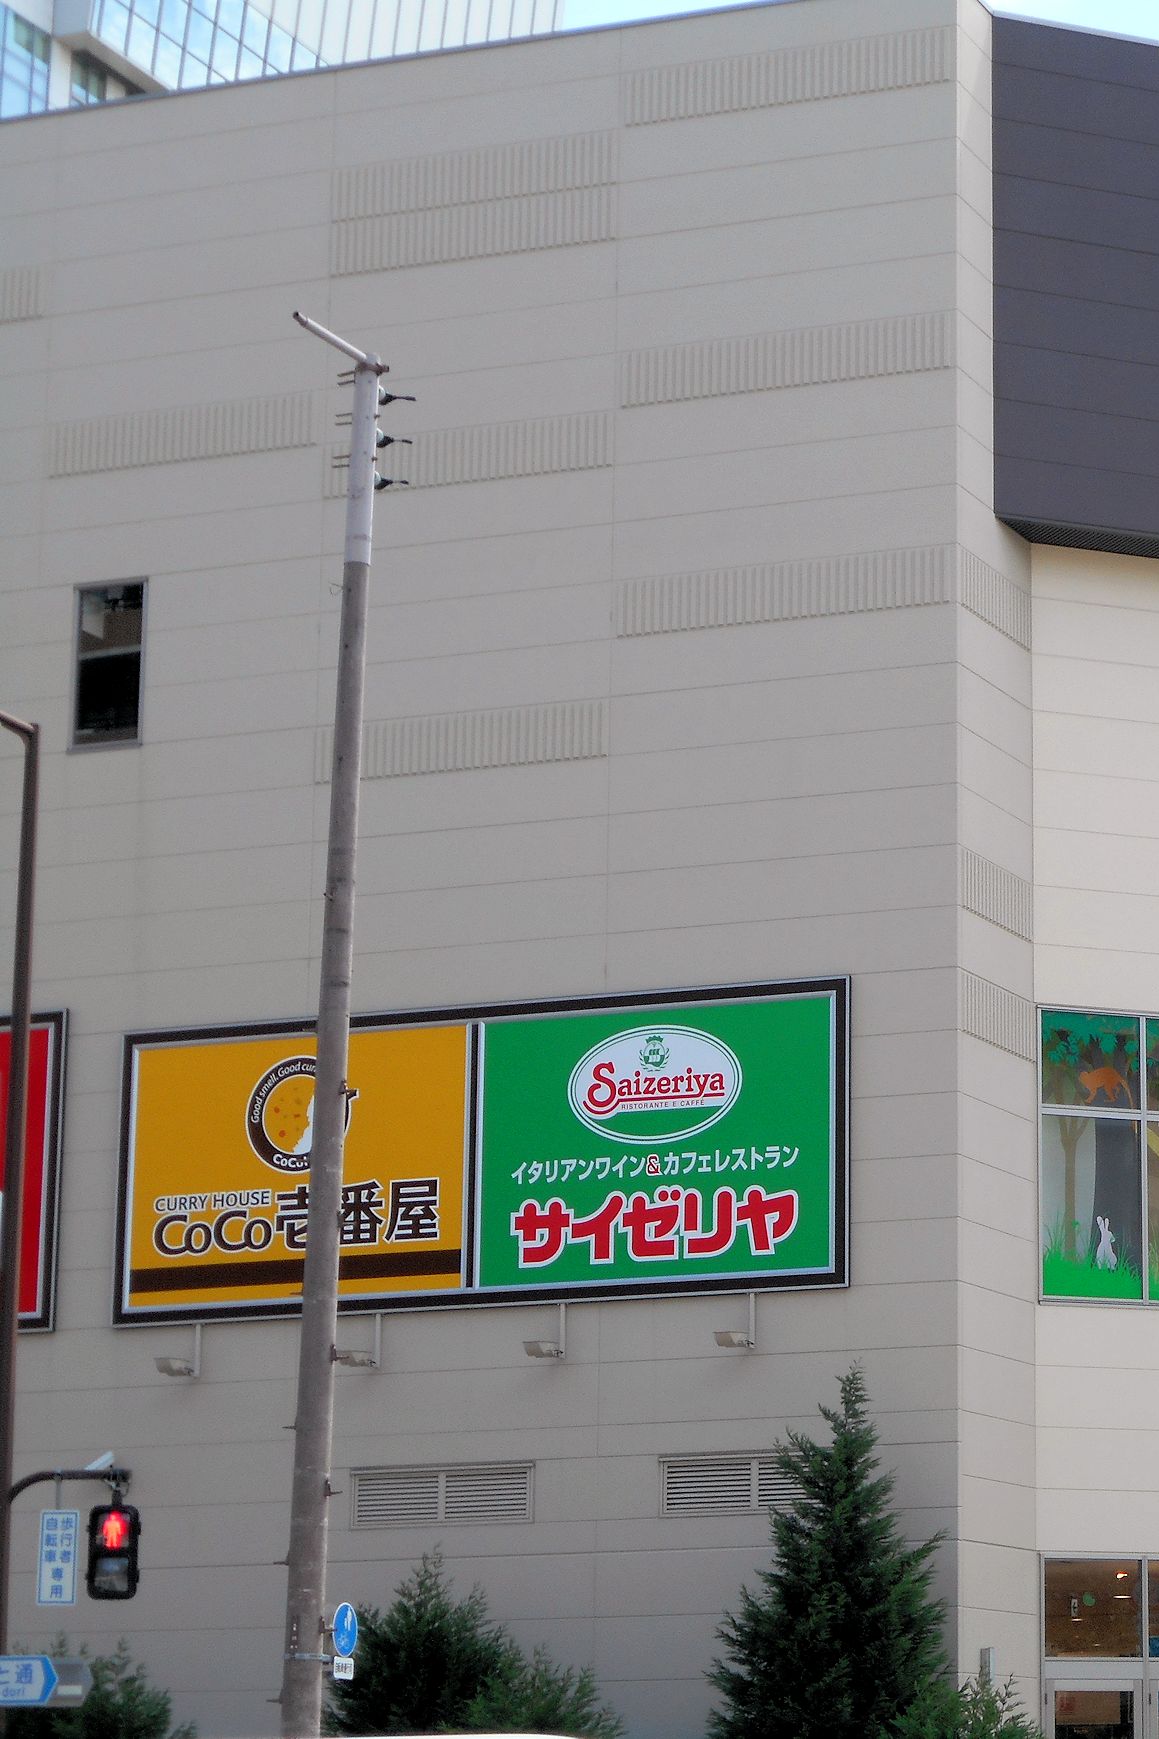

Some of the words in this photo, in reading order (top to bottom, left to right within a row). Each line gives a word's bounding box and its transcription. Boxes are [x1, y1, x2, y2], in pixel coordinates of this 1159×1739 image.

[250, 1096, 263, 1124] Good
[278, 1061, 301, 1078] Good
[583, 1061, 725, 1115] Saizeriya
[620, 1102, 669, 1111] RISTORANTE
[155, 1196, 208, 1212] CURRY
[212, 1190, 271, 1207] HOUSE
[512, 1186, 798, 1267] サイゼリヤ
